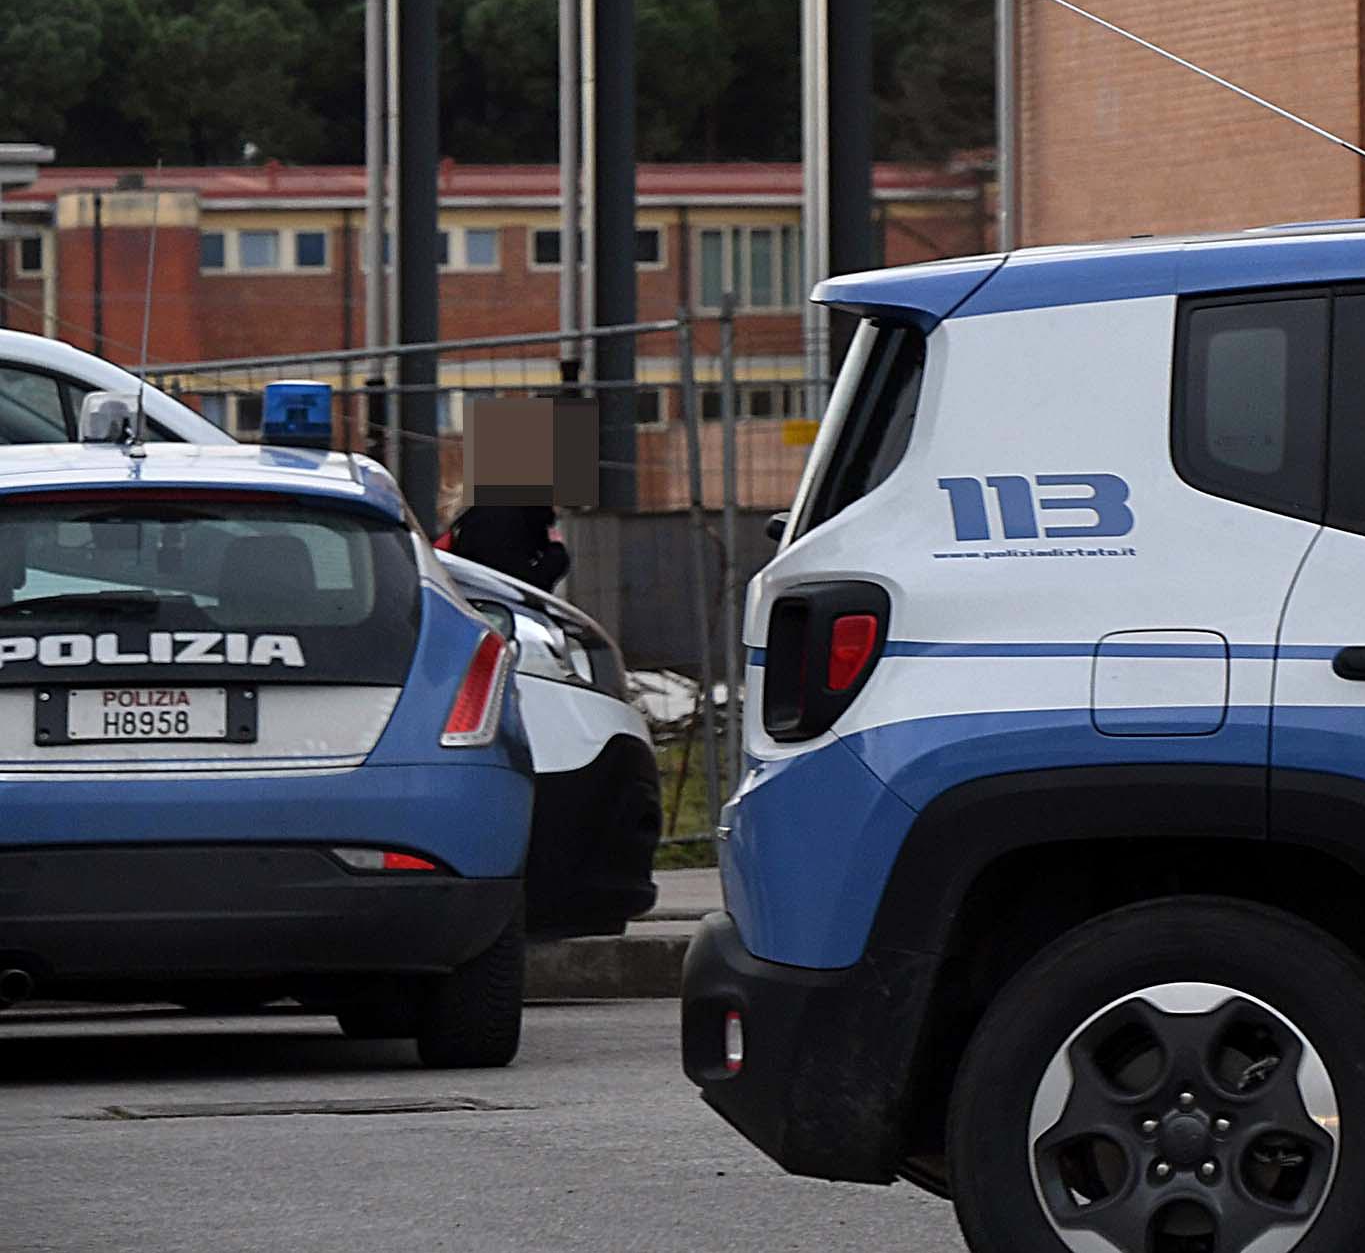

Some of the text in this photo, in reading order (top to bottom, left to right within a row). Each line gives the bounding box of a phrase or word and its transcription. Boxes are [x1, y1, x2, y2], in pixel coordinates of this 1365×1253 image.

[937, 473, 1134, 541] 113
[0, 632, 306, 667] POLIZIA
[103, 691, 191, 707] POLIZIA
[103, 711, 190, 735] H8958
